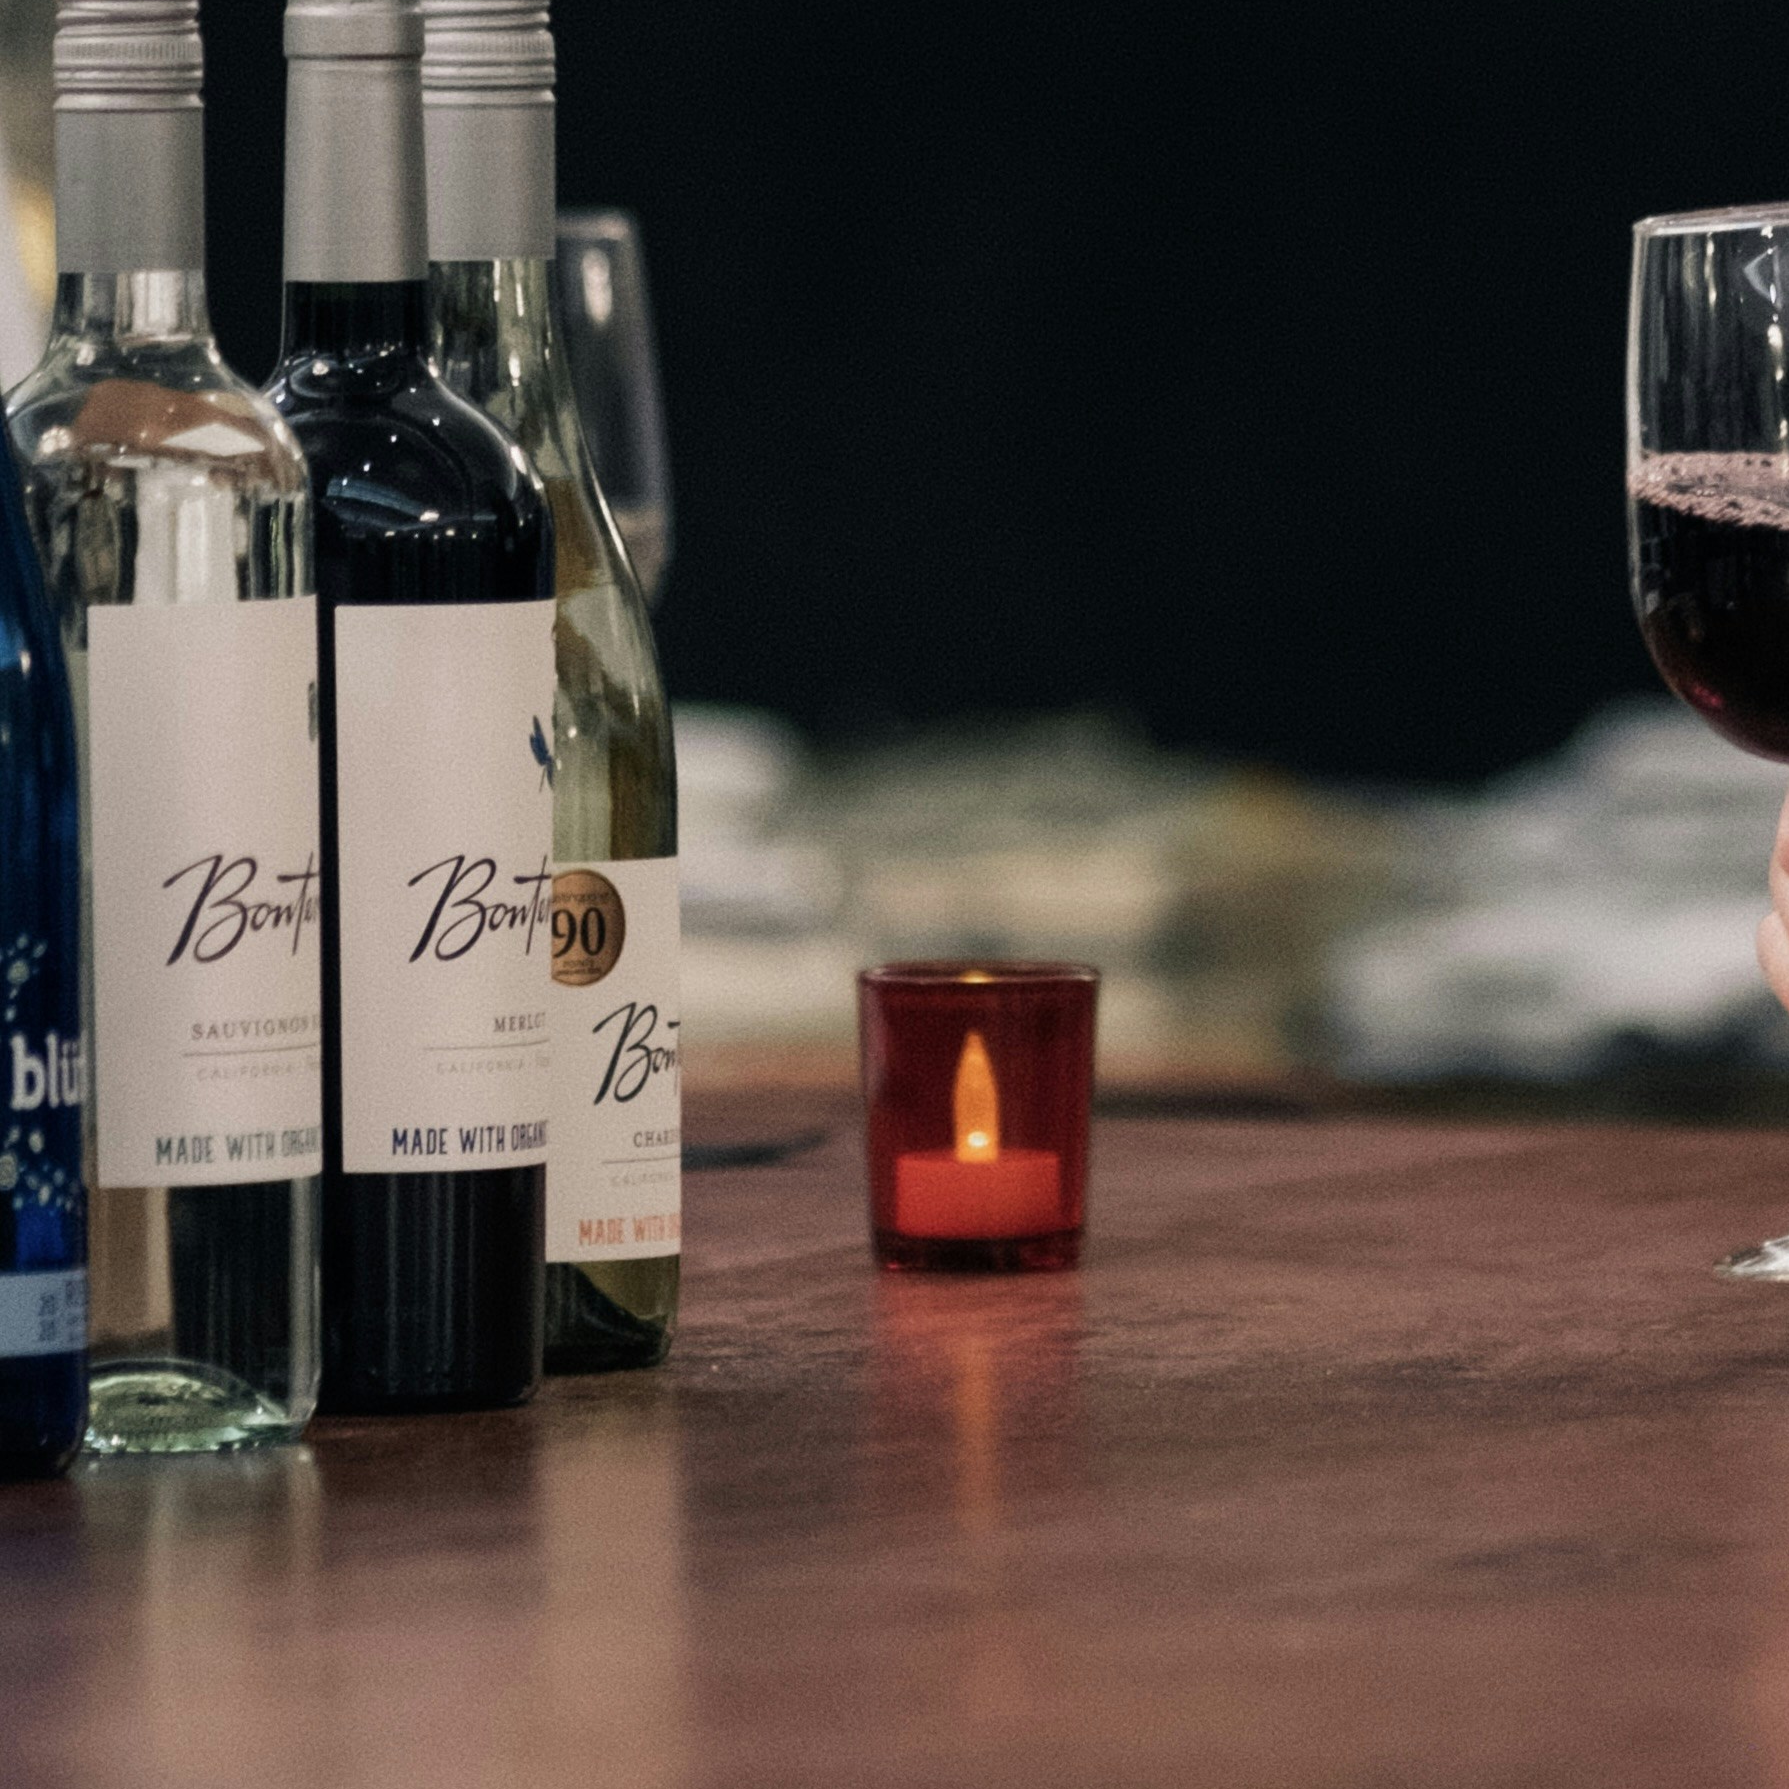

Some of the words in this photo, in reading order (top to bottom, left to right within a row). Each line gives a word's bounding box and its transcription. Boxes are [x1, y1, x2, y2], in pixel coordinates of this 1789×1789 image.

[551, 907, 606, 958] 90
[156, 1136, 213, 1165] MADE
[226, 1131, 275, 1161] WITH
[392, 1128, 447, 1155] MADE
[459, 1125, 505, 1154] WITH
[579, 1218, 623, 1245] MADE
